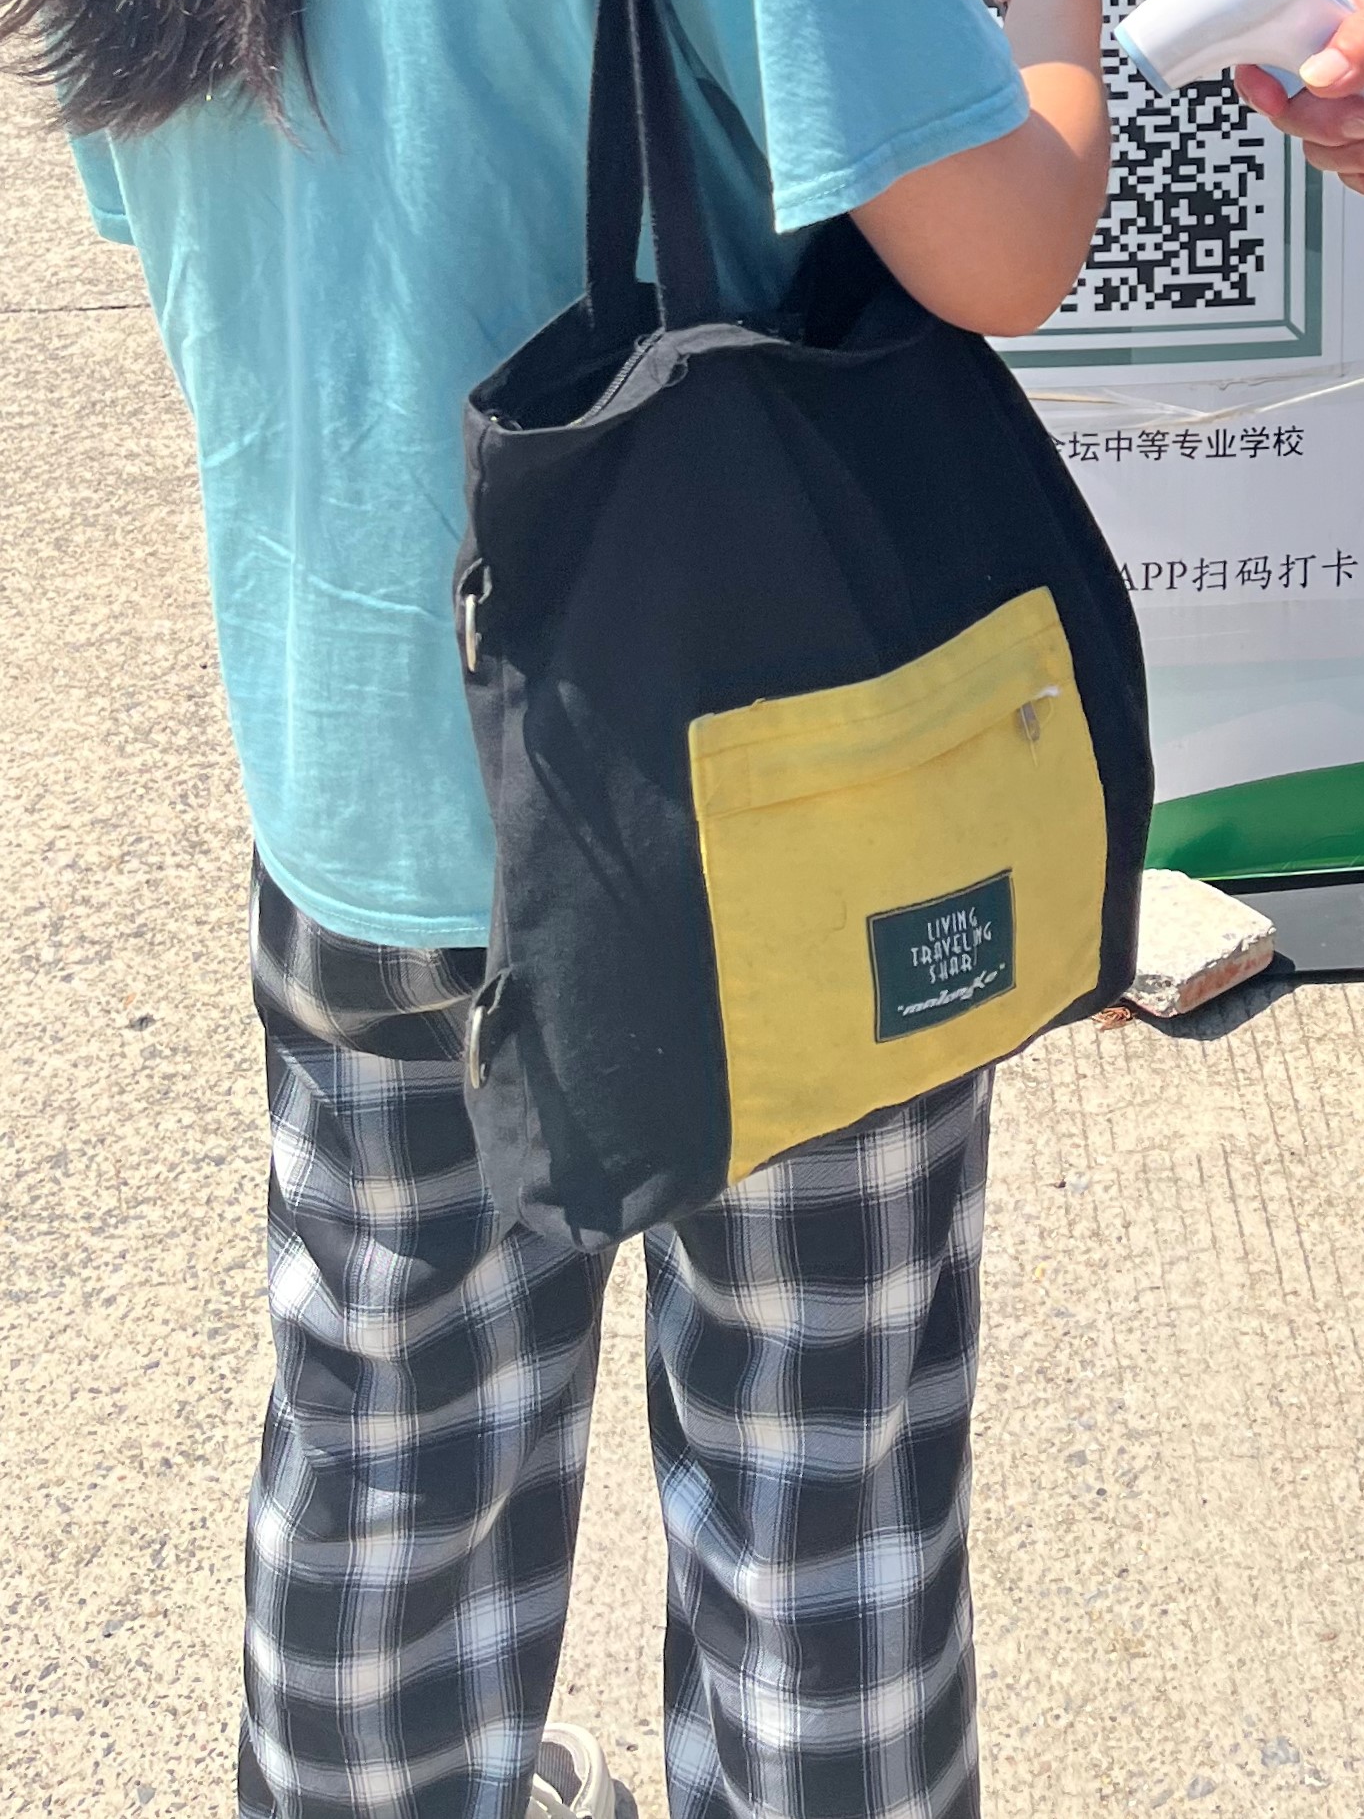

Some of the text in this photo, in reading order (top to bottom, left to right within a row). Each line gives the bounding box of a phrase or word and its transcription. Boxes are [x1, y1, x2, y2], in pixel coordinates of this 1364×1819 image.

[1119, 548, 1358, 593] APP扫码打卡
[927, 907, 978, 942] LIVING
